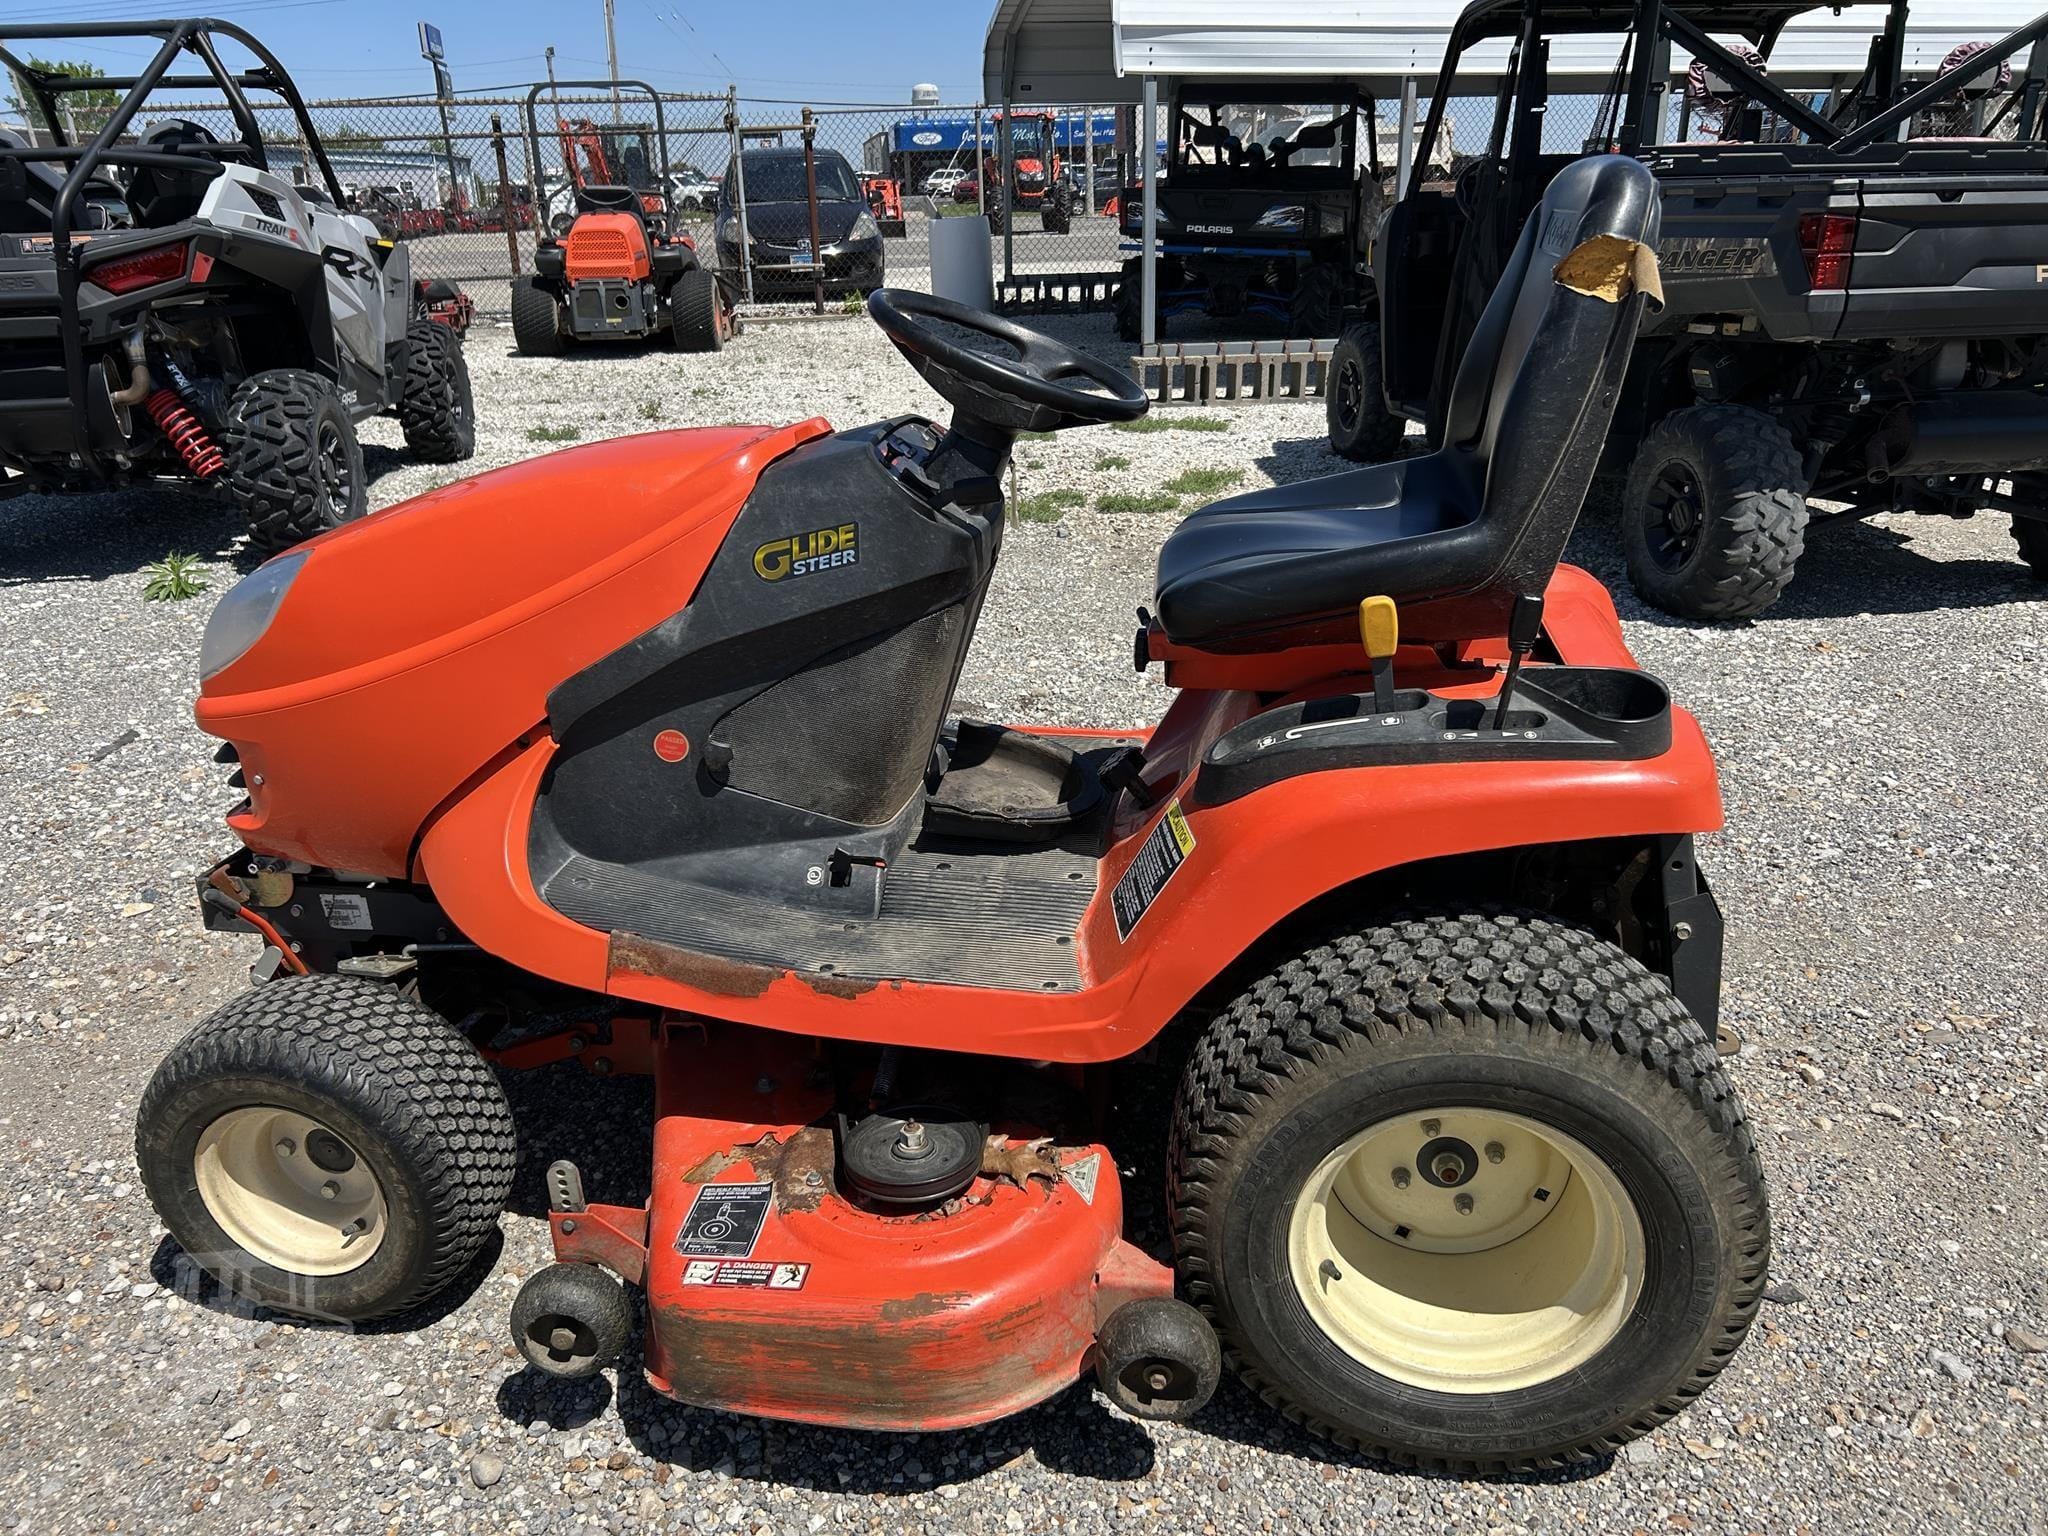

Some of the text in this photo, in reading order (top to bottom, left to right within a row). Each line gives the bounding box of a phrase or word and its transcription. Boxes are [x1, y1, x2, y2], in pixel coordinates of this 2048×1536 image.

[256, 218, 287, 238] TRAIL
[1186, 224, 1234, 234] POLARIS
[342, 390, 358, 404] ARIS
[754, 523, 856, 580] GLIDE
[793, 549, 856, 575] STEER
[1172, 814, 1190, 848] CAUTION
[1656, 1152, 1714, 1243] SUPER
[733, 1262, 773, 1270] DANGER
